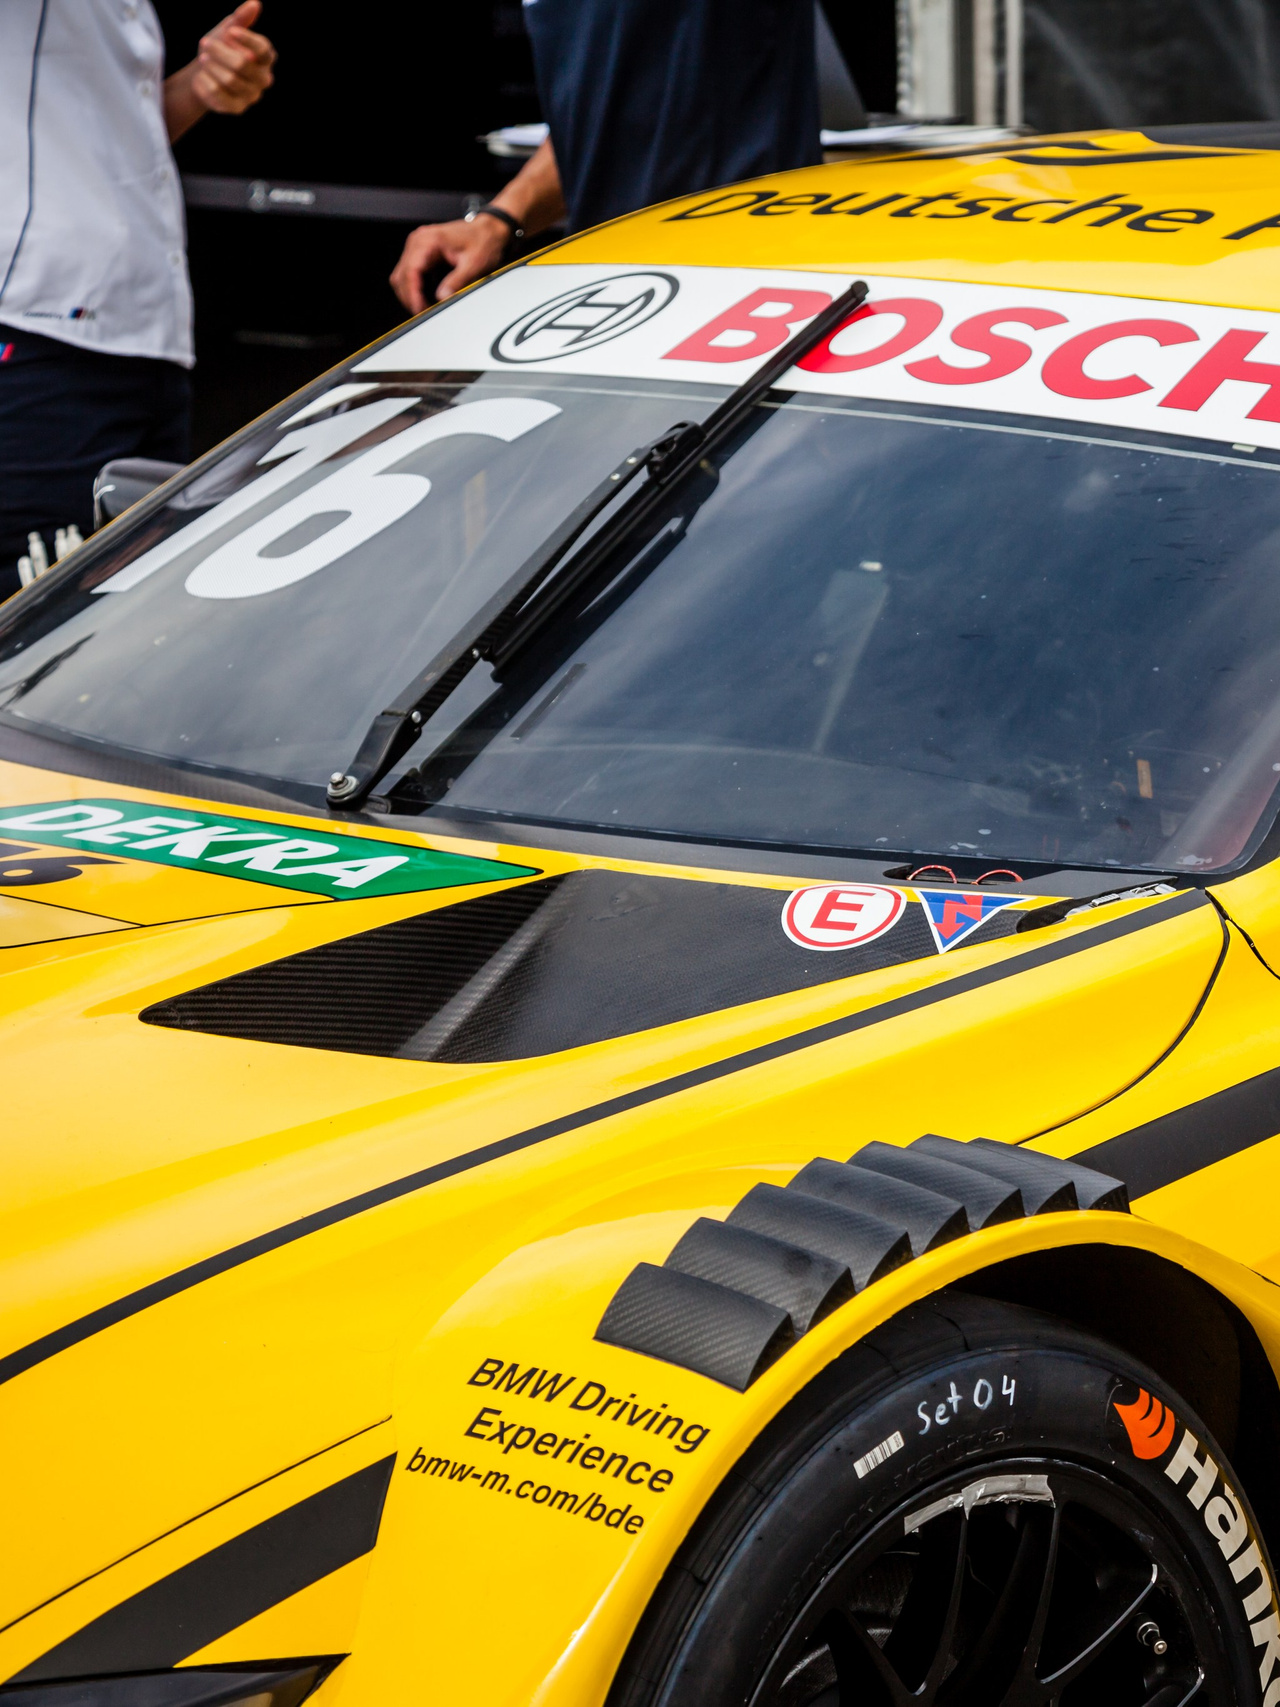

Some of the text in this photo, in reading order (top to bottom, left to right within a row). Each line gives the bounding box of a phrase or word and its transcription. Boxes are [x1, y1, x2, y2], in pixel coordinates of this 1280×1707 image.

[661, 190, 1215, 235] Deutsche
[90, 394, 564, 599] 16
[0, 804, 410, 889] DEKRA
[811, 891, 877, 931] E
[466, 1357, 711, 1454] BMW Driving
[917, 1375, 1016, 1435] Set 04
[404, 1447, 645, 1535] bmw-m.com/bde
[464, 1407, 675, 1494] Experience
